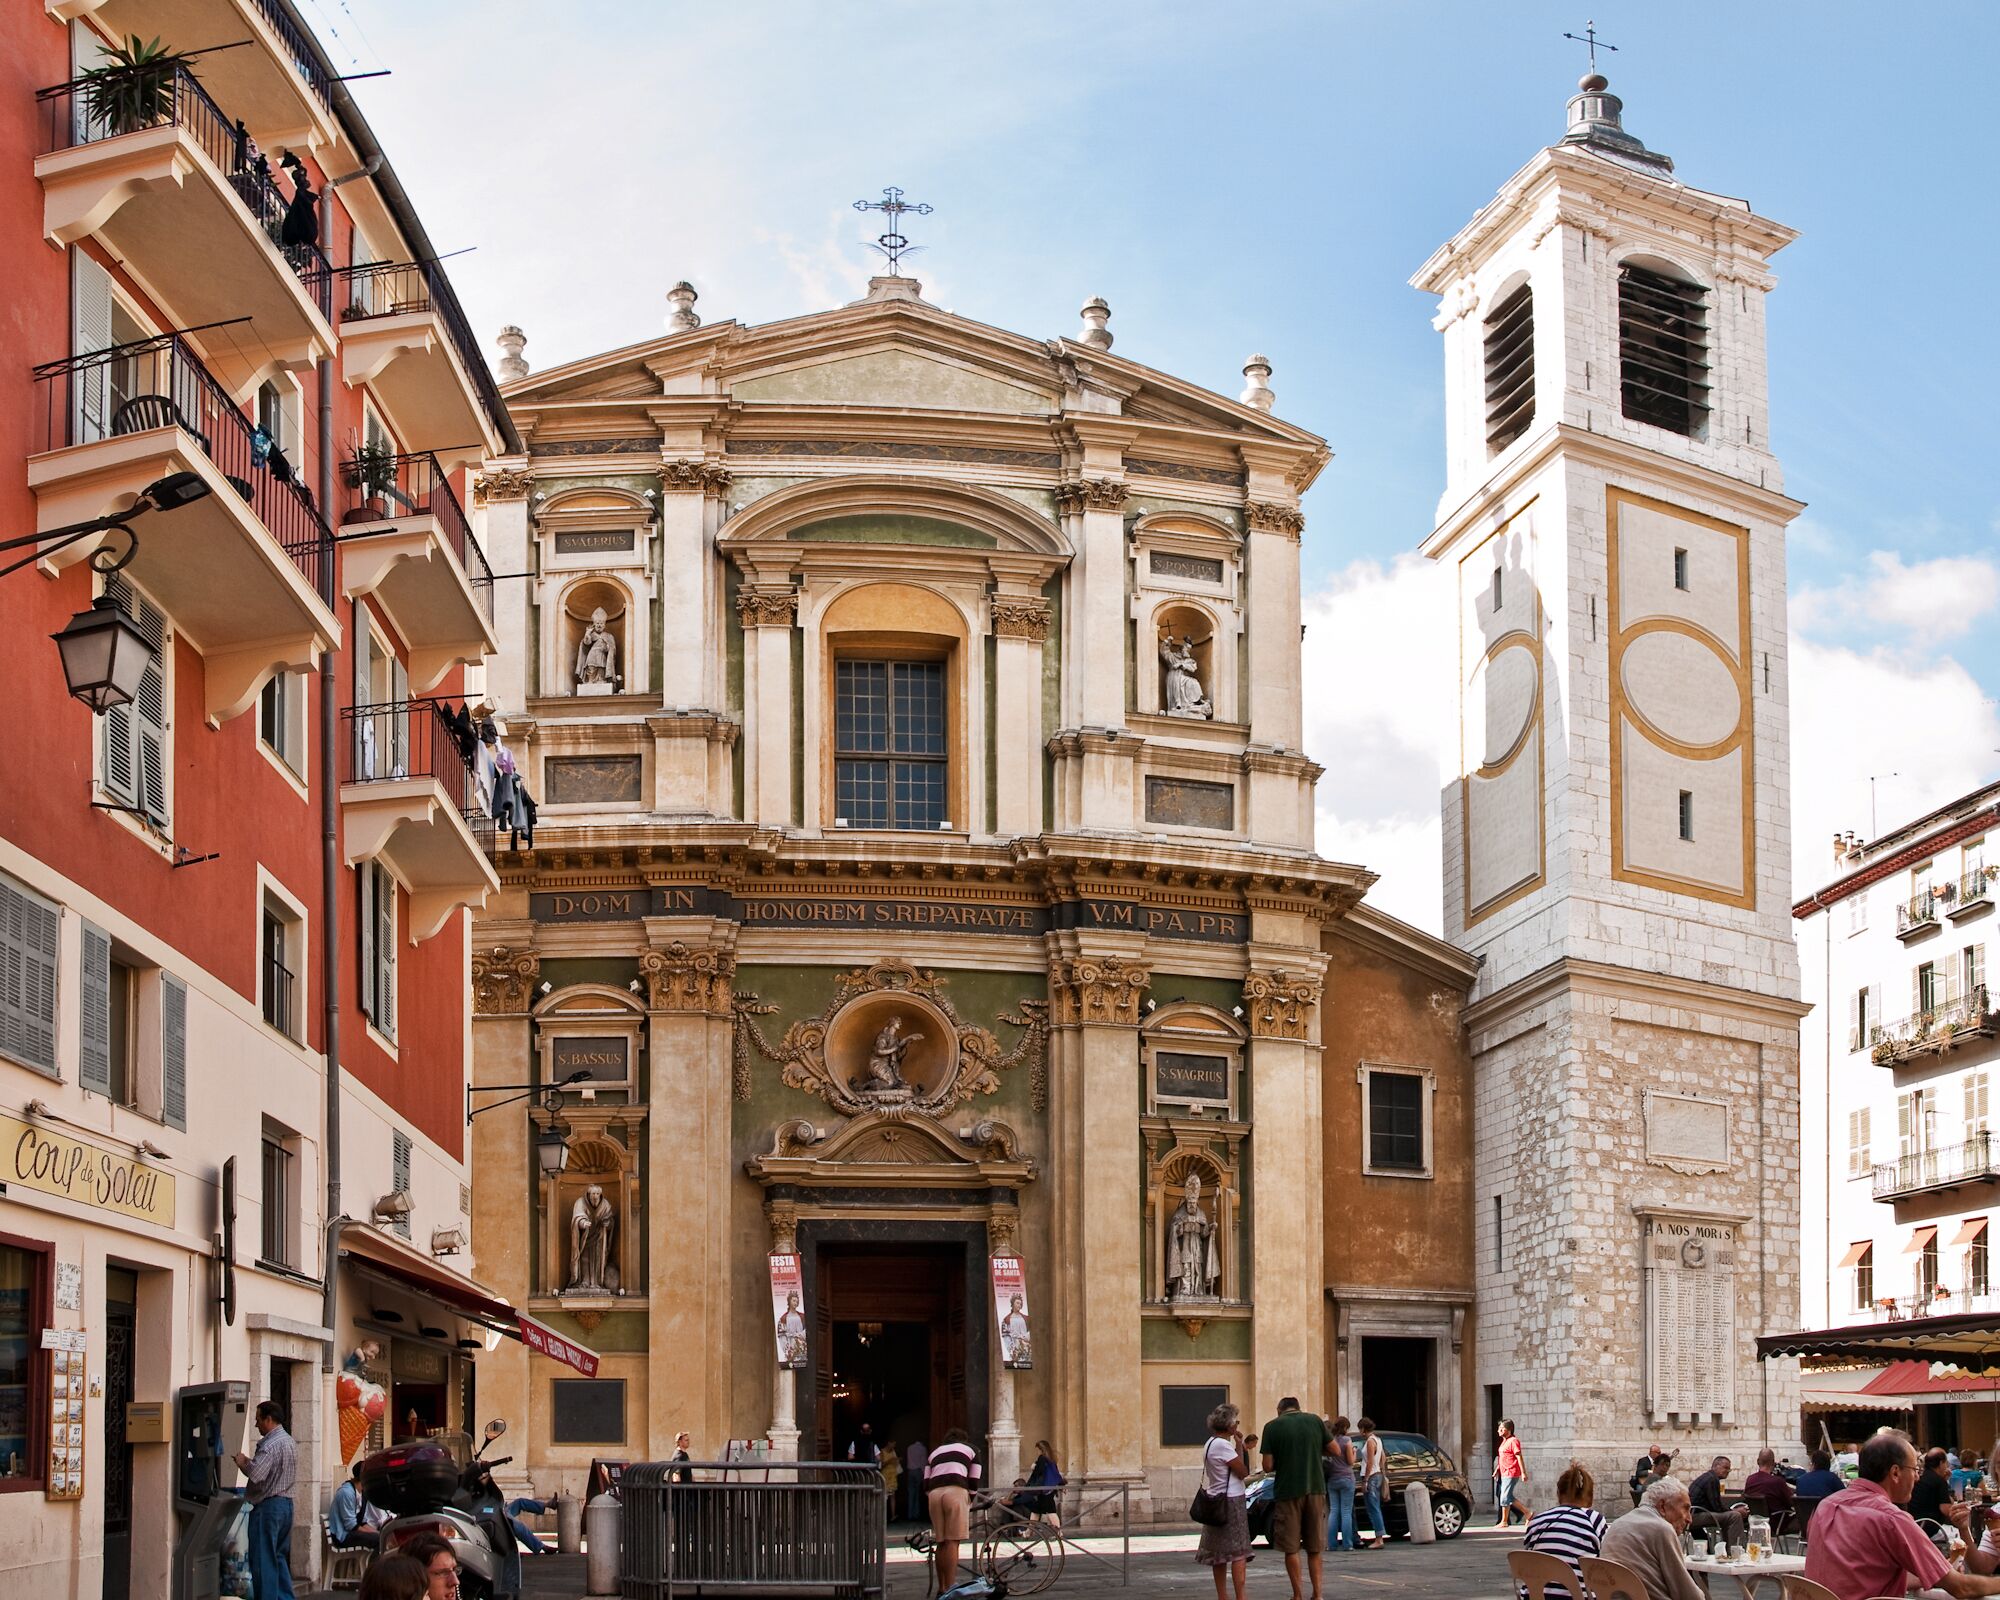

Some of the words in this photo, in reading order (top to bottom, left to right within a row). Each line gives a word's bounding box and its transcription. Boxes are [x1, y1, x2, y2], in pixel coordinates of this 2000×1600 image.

[663, 890, 695, 909] IN
[744, 902, 866, 921] HONOREM
[15, 1128, 83, 1194] Coup
[80, 1161, 95, 1184] de
[96, 1154, 158, 1213] Soleil
[1656, 1223, 1663, 1234] A
[1668, 1224, 1690, 1236] NOS
[770, 1255, 796, 1267] FESTA
[992, 1258, 1019, 1269] FESTA
